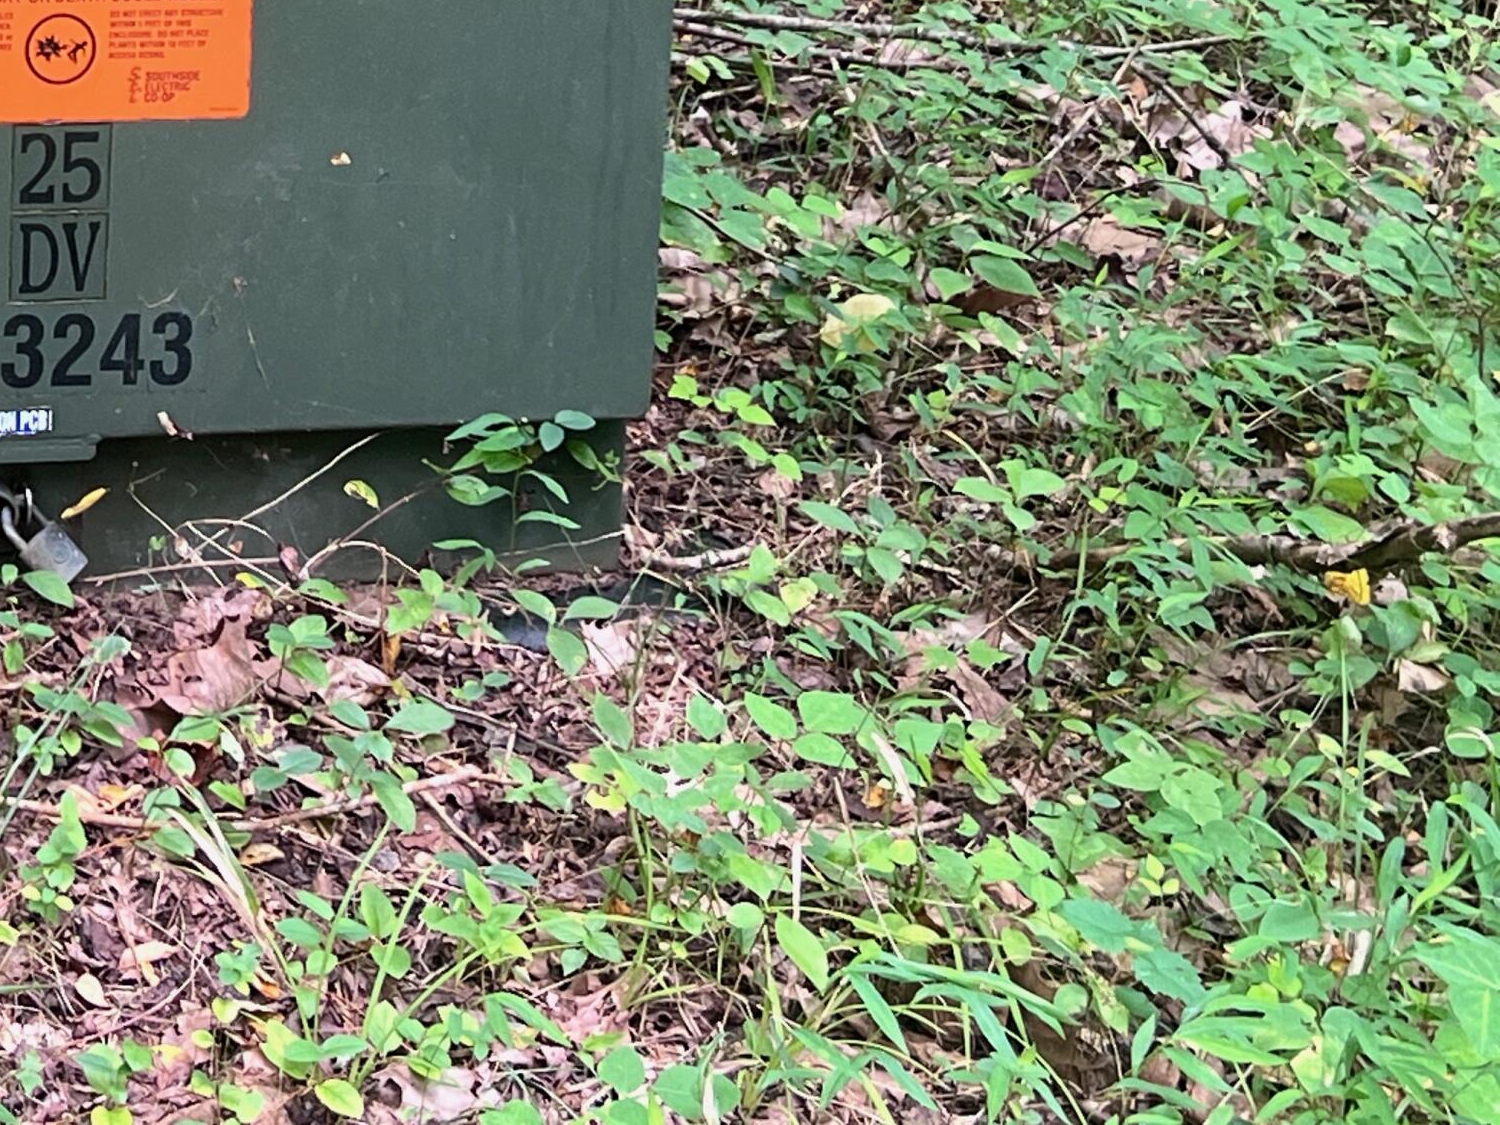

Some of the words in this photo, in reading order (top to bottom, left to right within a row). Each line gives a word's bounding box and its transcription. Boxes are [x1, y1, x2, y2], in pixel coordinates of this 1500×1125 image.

[18, 130, 102, 205] 25
[18, 220, 101, 294] DV
[20, 408, 49, 432] PCB
